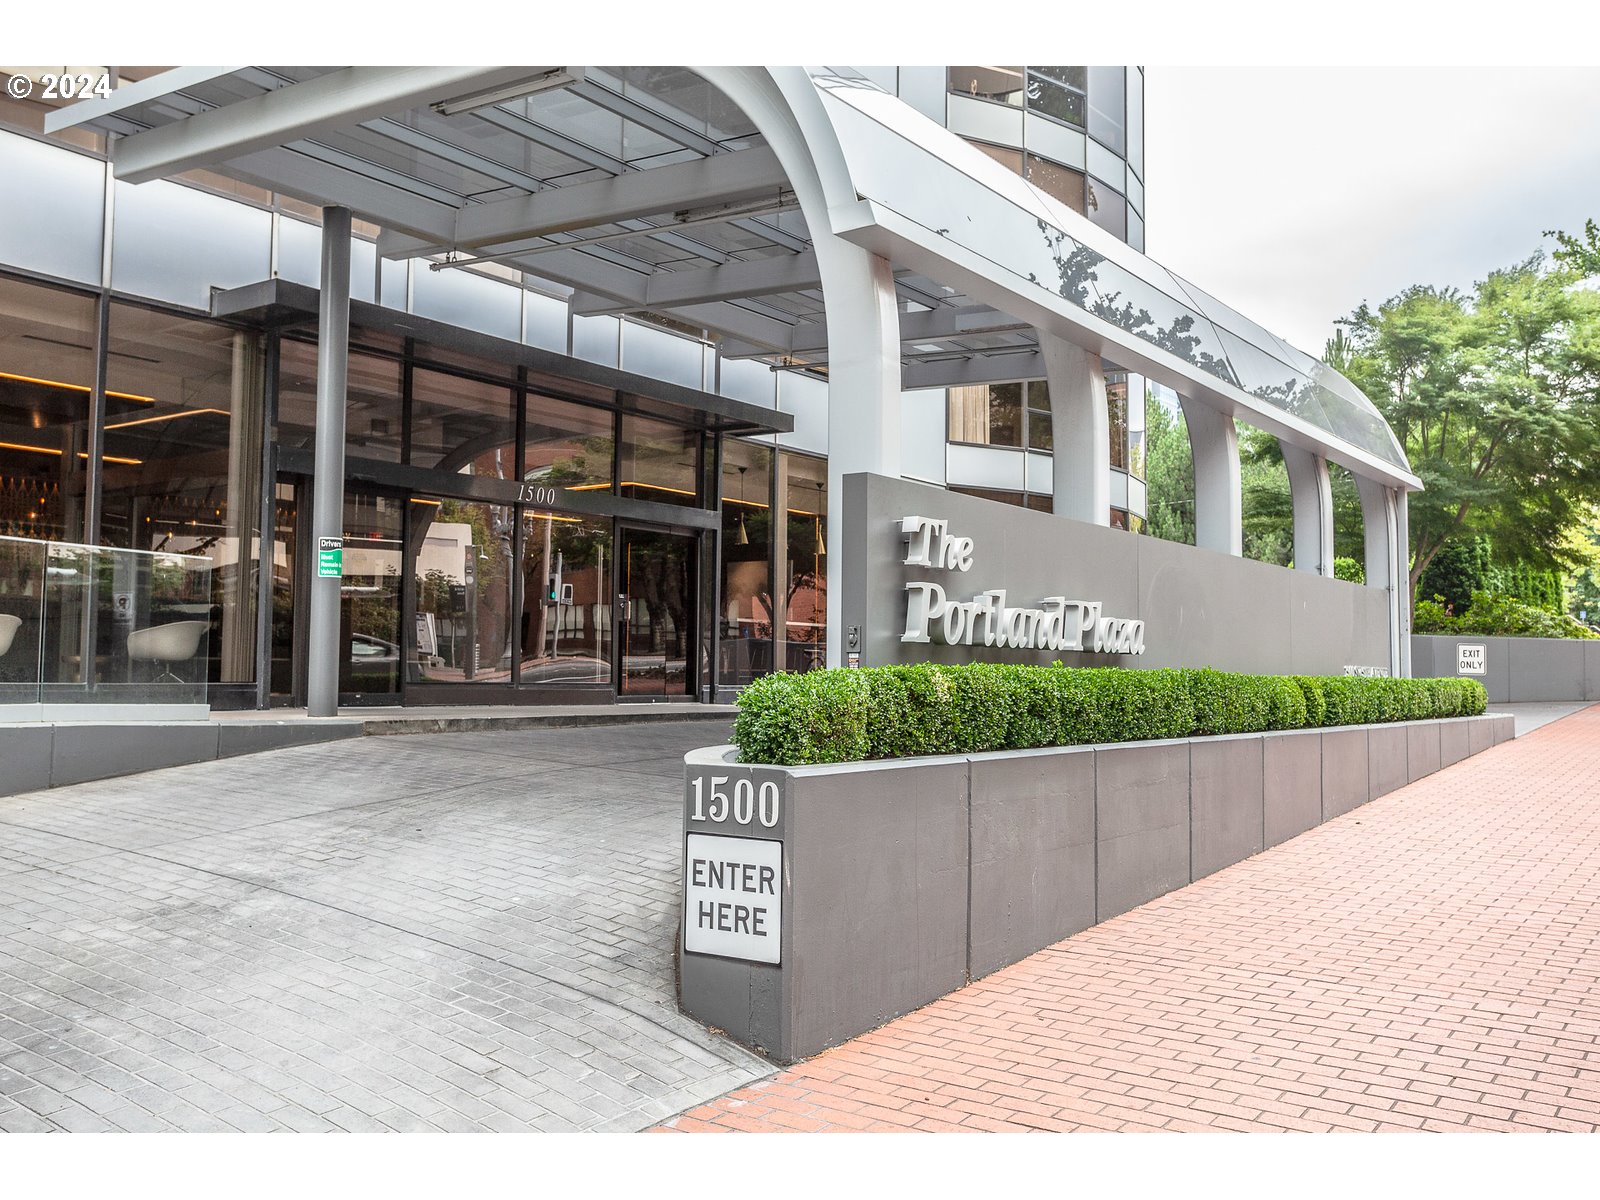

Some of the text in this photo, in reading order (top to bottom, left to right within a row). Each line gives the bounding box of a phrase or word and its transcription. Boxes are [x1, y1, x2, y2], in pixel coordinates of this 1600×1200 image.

[518, 484, 555, 505] 1500
[901, 515, 974, 572] The
[901, 582, 1146, 656] Portland Plaza
[1460, 660, 1483, 670] ONLY
[1462, 649, 1481, 658] EXIT
[690, 775, 780, 829] 1500
[692, 858, 775, 896] ENTER
[698, 900, 768, 937] HERE
